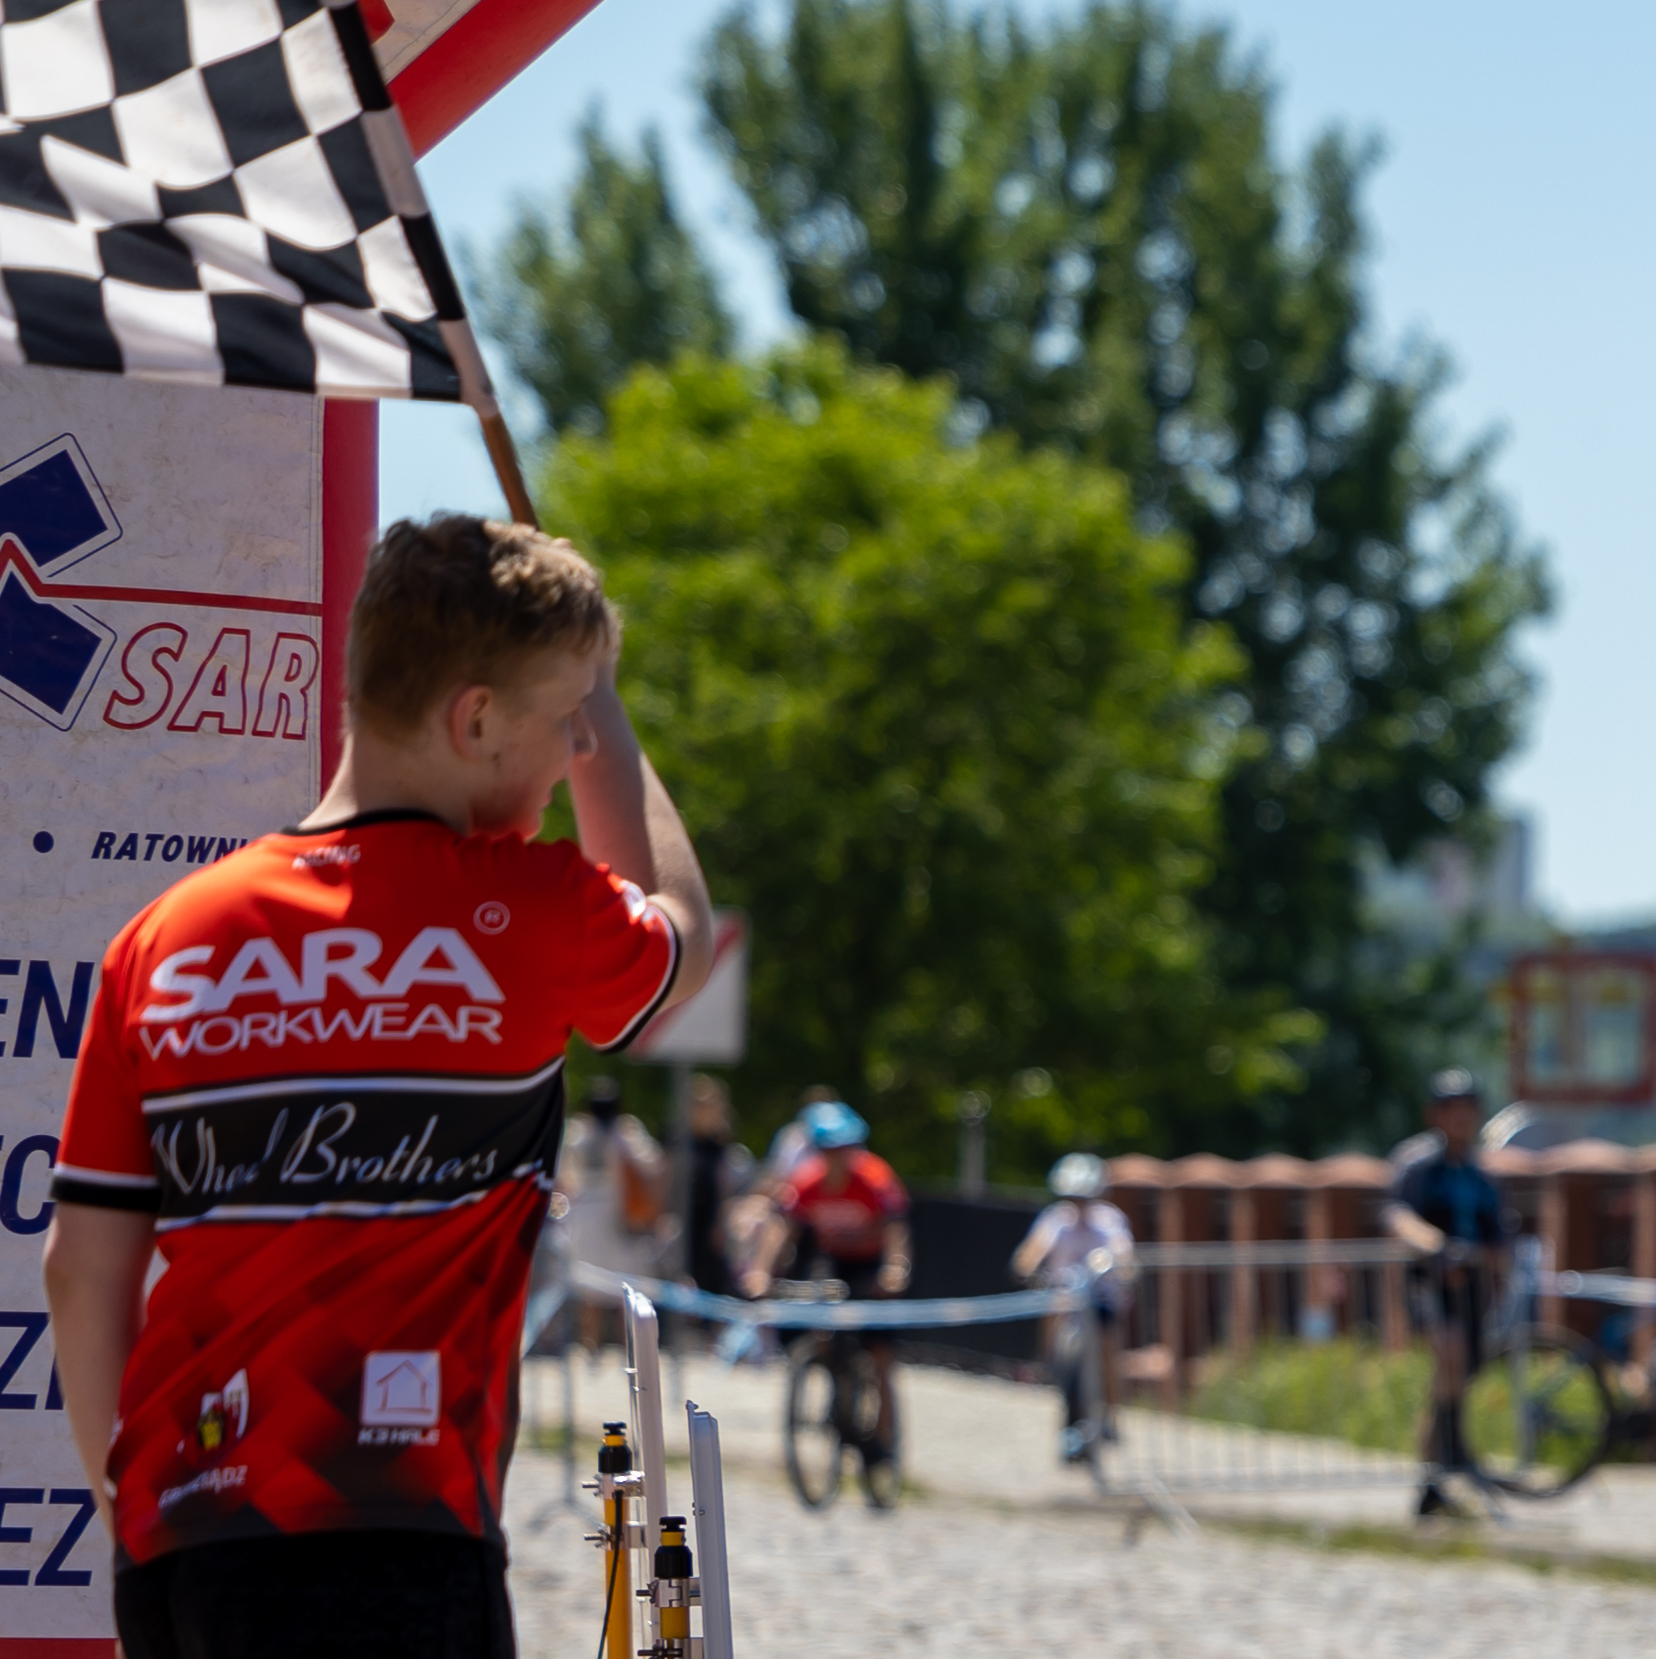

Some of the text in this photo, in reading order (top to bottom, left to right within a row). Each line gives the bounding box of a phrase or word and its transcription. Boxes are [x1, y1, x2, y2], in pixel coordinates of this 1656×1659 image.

[103, 622, 319, 740] SAR
[0, 959, 95, 1059] N
[139, 926, 505, 1023] SARA
[138, 1002, 503, 1061] WORKWEAR
[0, 1134, 61, 1235] C
[280, 1102, 498, 1185] Brothers
